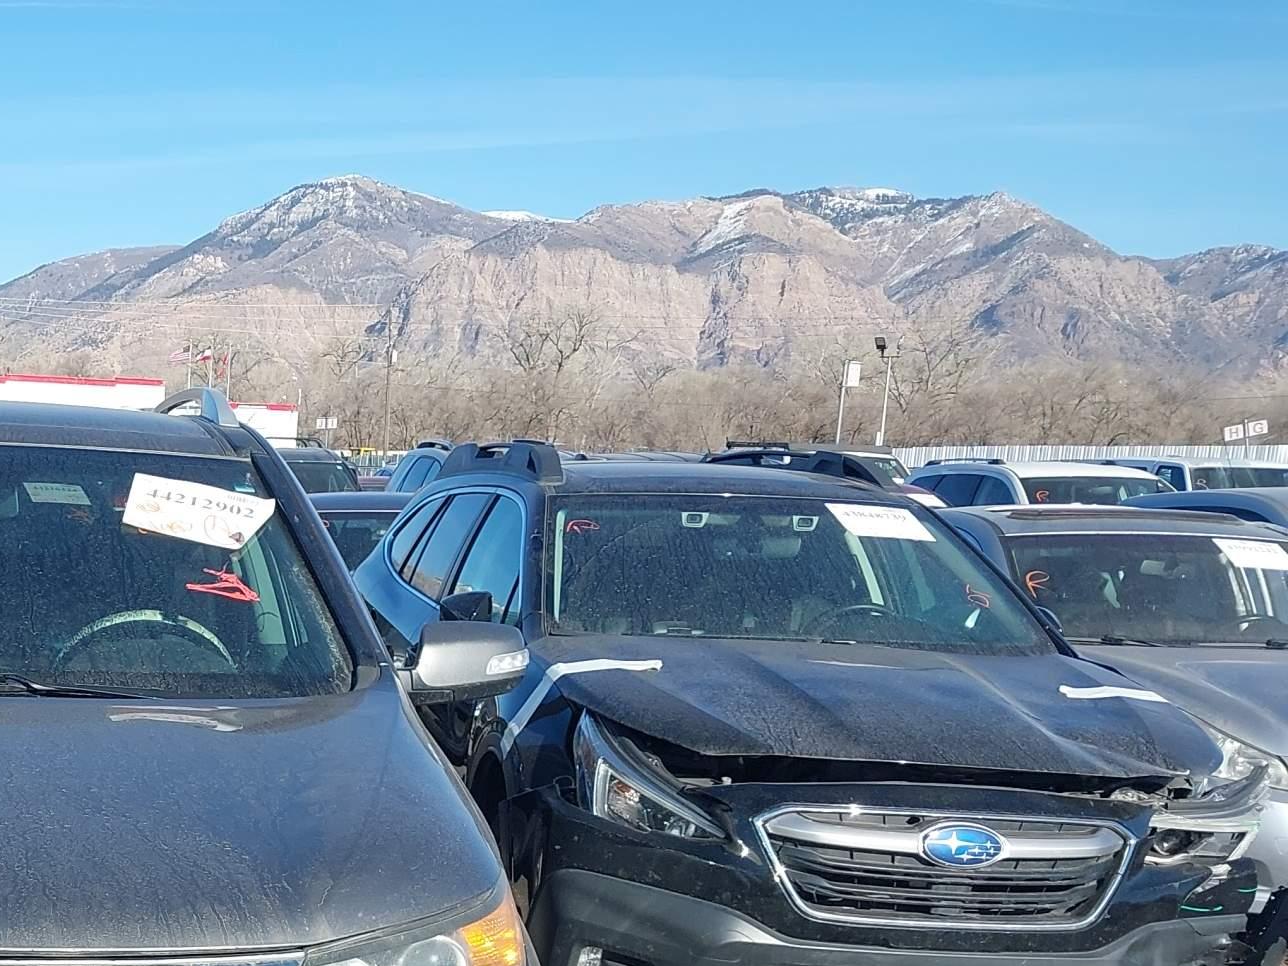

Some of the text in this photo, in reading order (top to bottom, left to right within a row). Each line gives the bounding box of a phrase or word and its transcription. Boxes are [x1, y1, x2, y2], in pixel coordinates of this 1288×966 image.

[1229, 427, 1239, 439] H
[1253, 422, 1264, 434] G
[144, 487, 256, 520] 44212902
[1025, 570, 1050, 599] R
